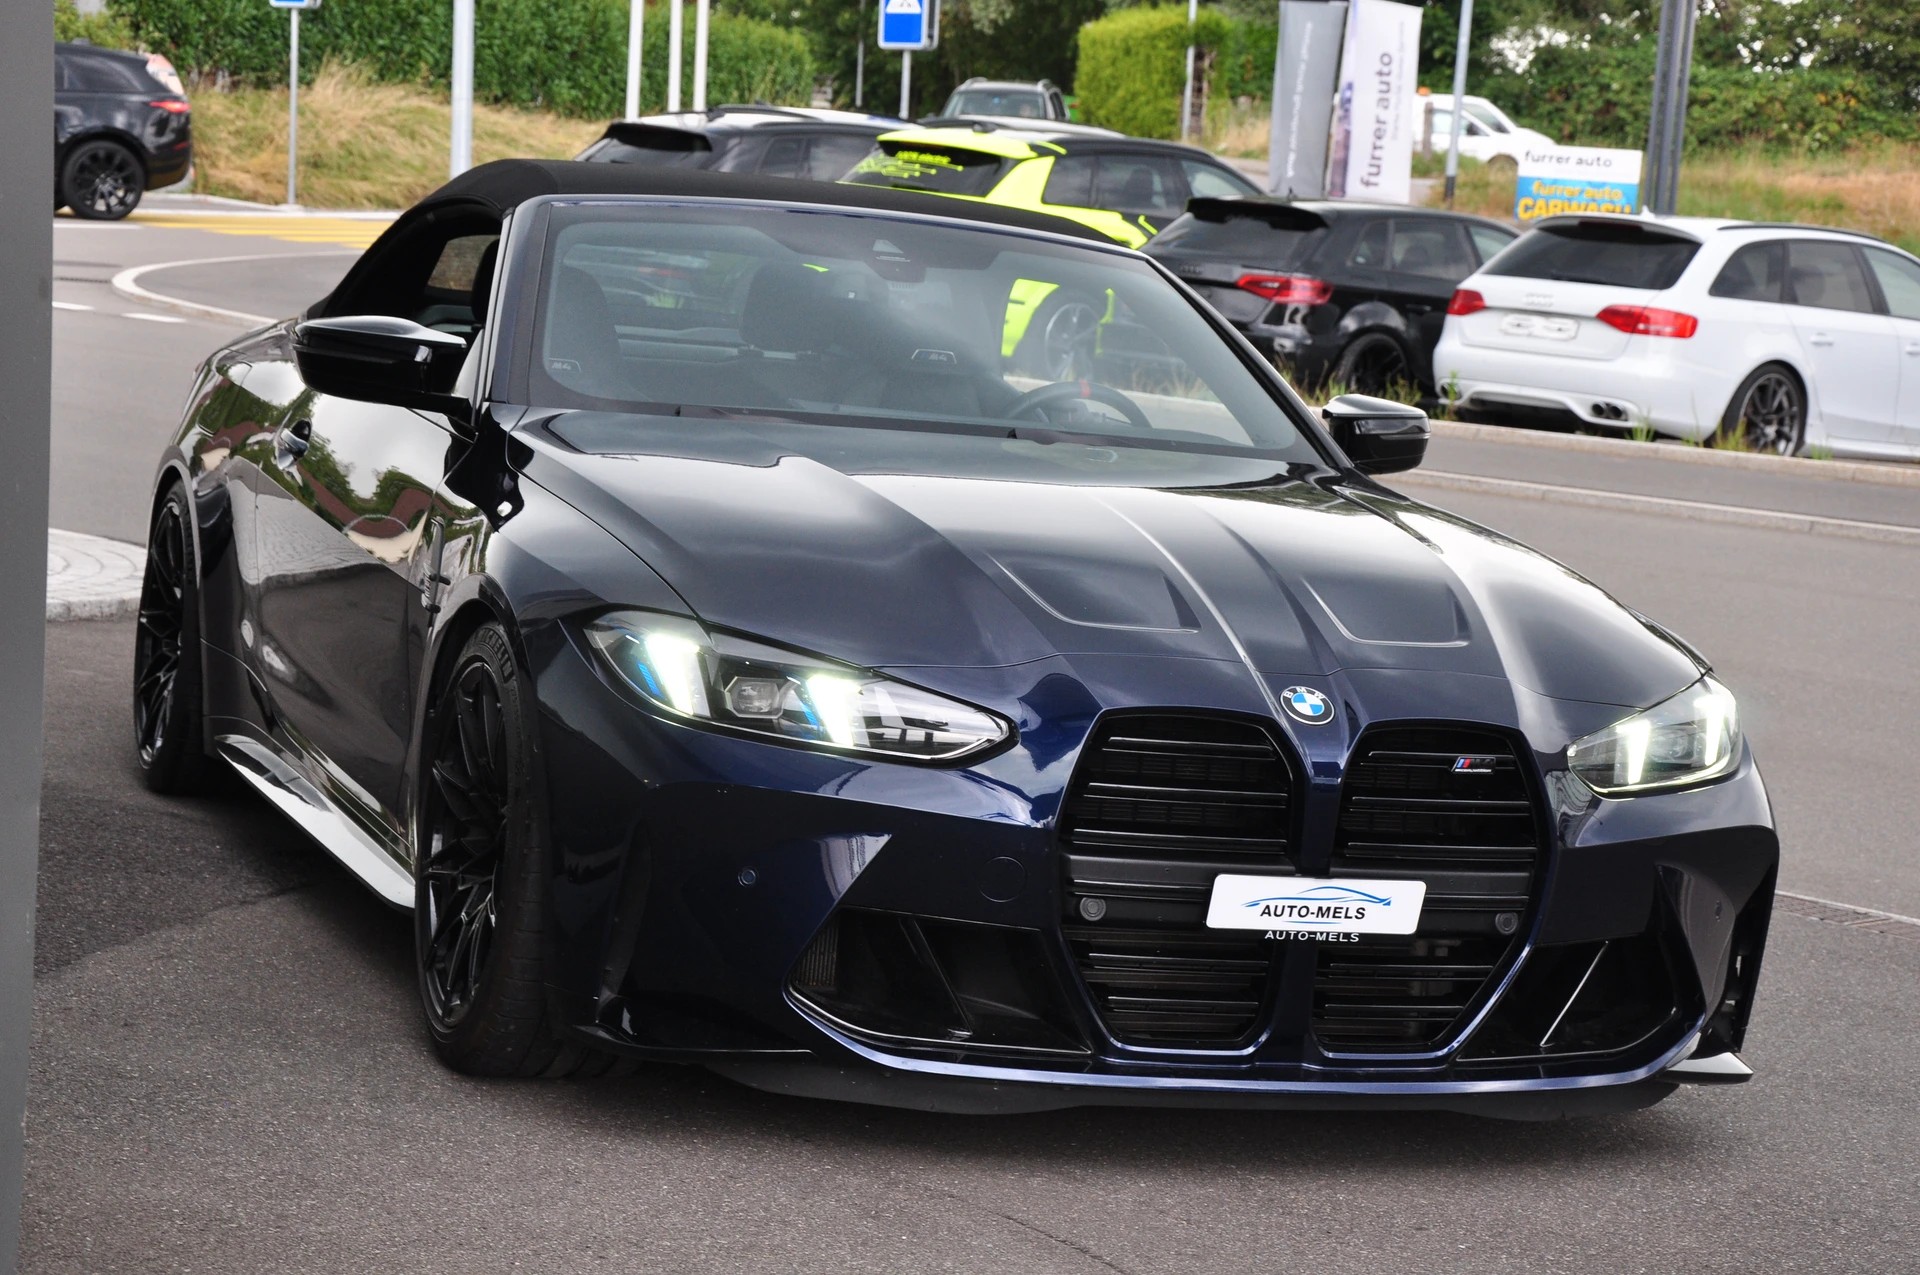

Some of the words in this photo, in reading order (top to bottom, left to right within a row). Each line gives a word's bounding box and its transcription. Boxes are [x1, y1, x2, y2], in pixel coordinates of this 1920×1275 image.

[1360, 115, 1388, 189] furrer
[1375, 52, 1393, 110] auto
[1524, 150, 1571, 164] furrer
[1576, 156, 1613, 168] auto
[1532, 179, 1581, 198] furrer
[1583, 186, 1624, 201] auto
[1259, 904, 1367, 920] AUTO-MELS
[1264, 930, 1360, 943] AUTO-MELS
